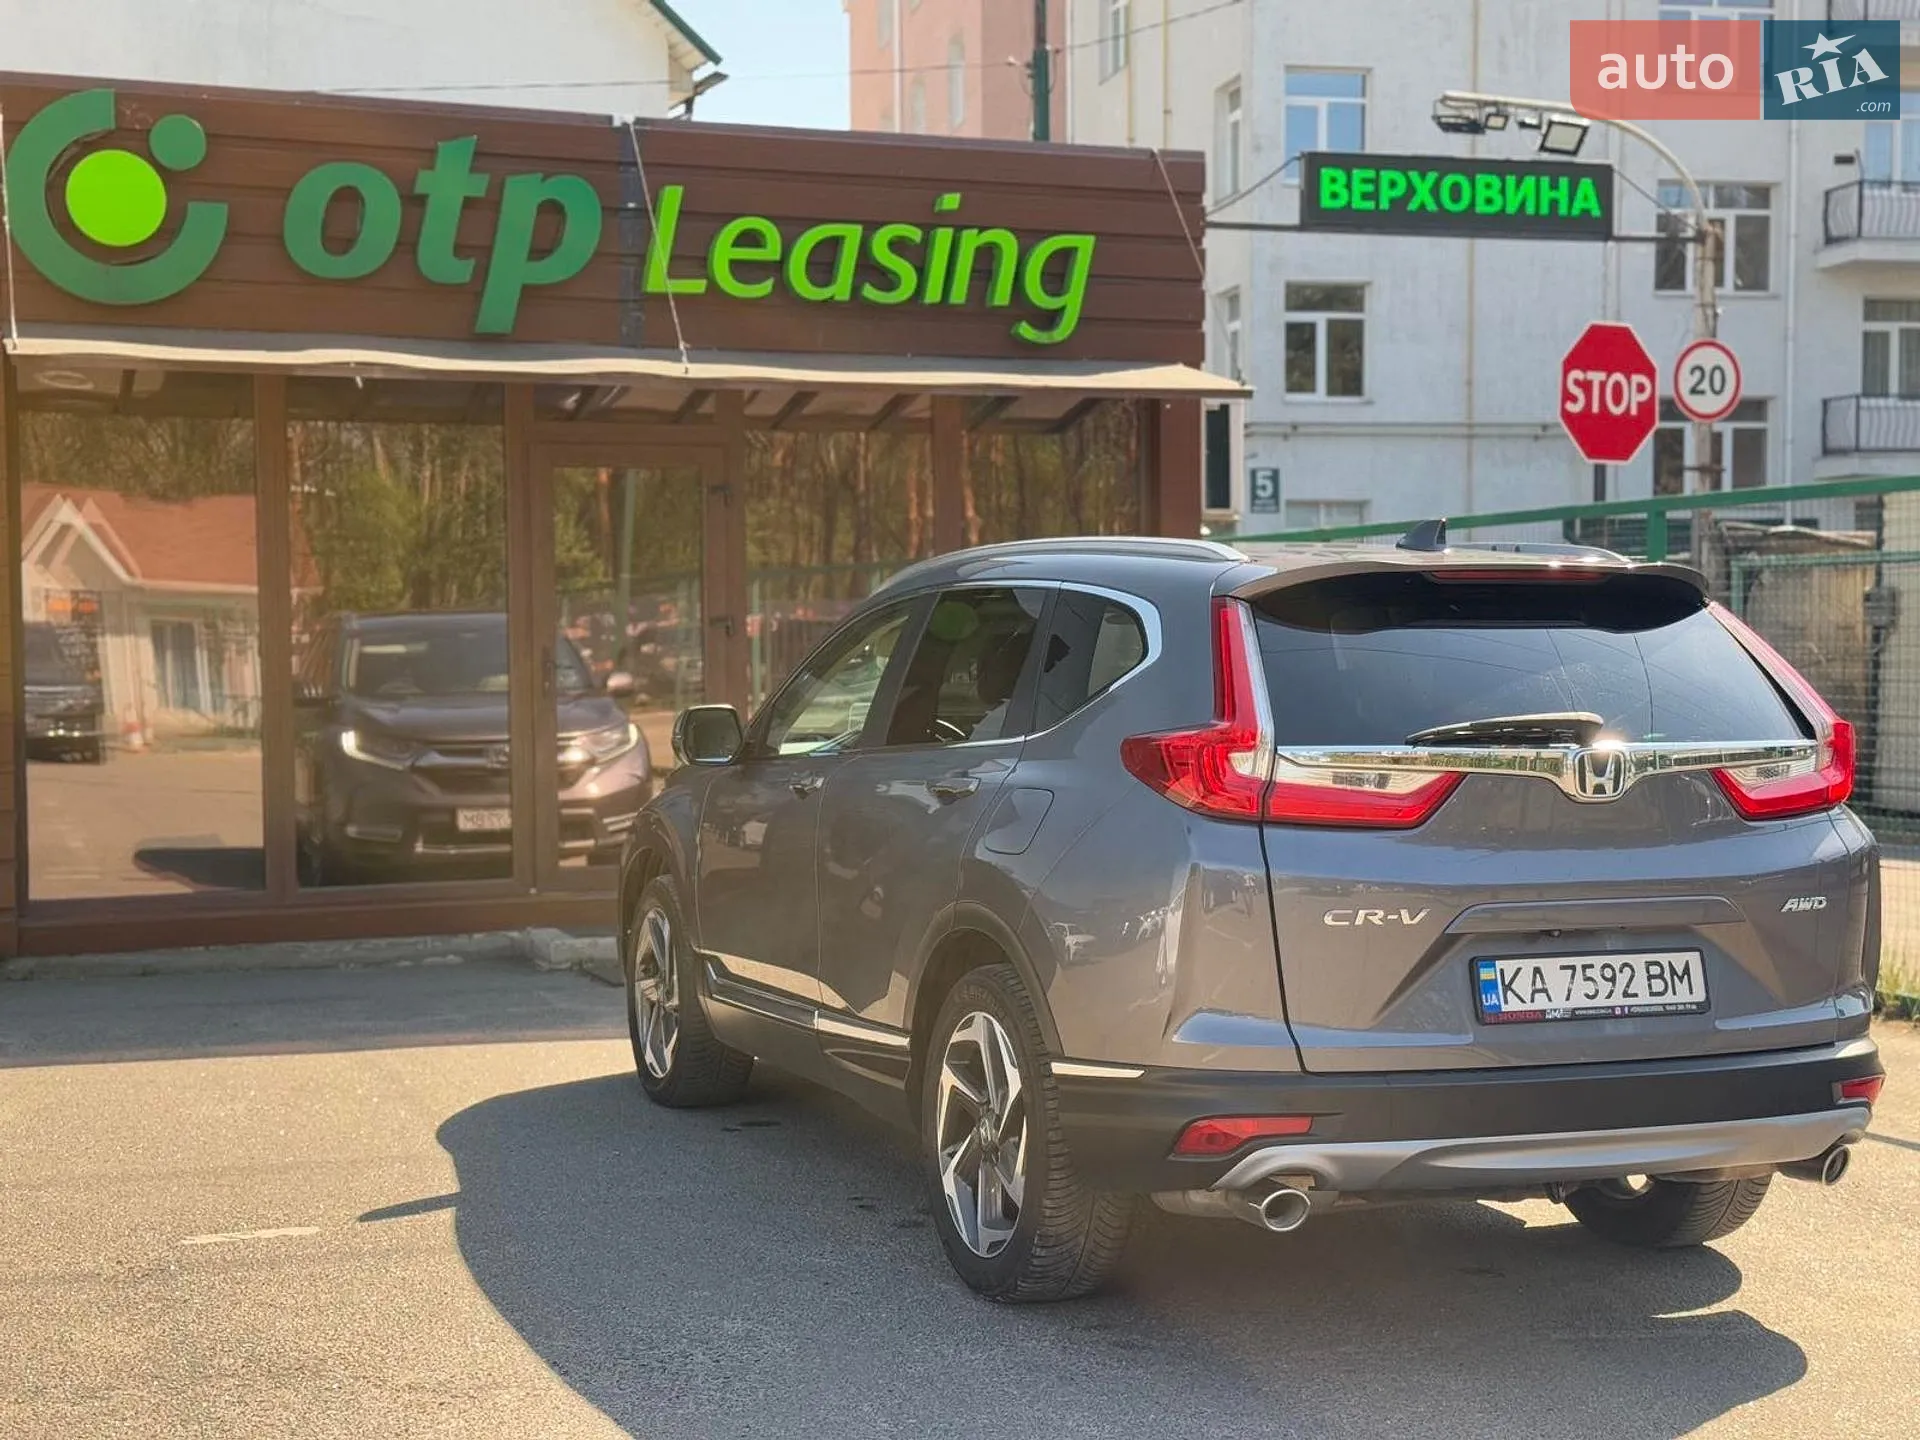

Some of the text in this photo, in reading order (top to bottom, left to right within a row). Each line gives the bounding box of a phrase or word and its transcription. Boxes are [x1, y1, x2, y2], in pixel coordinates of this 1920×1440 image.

[1319, 167, 1601, 218] ВЕРХОВИНА
[283, 135, 1096, 345] otp Leasing
[1564, 368, 1653, 416] STOP
[1688, 365, 1727, 396] 20
[1255, 470, 1274, 498] 5
[1323, 908, 1431, 926] CR-V
[1780, 896, 1828, 912] AWD
[1499, 959, 1694, 1005] KA 7592 BM
[1482, 994, 1500, 1006] UA
